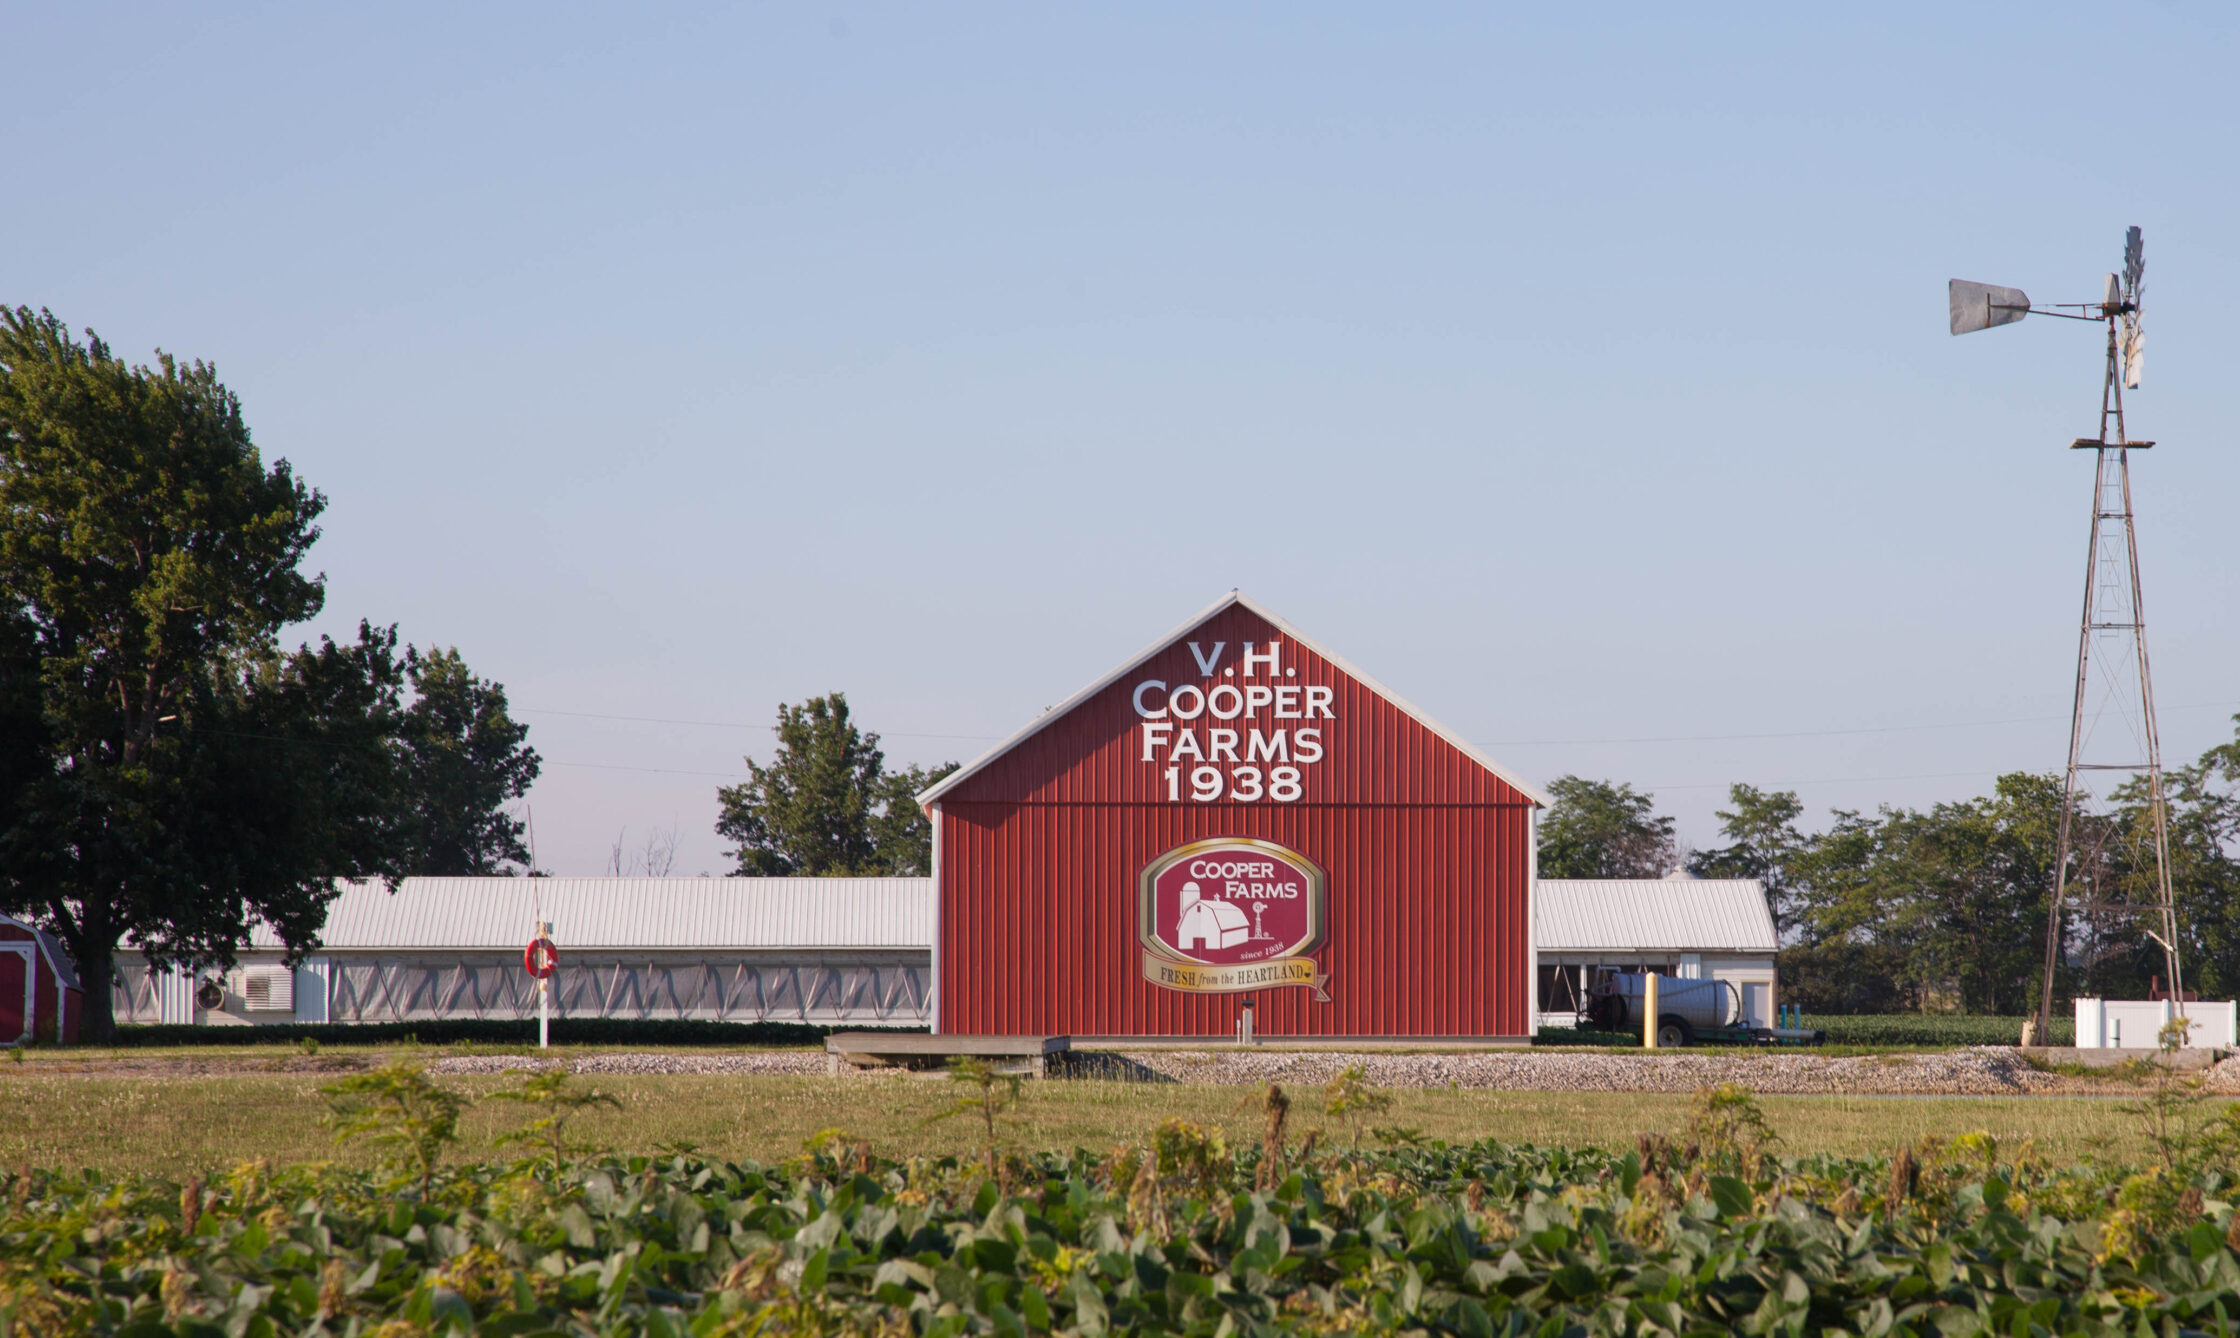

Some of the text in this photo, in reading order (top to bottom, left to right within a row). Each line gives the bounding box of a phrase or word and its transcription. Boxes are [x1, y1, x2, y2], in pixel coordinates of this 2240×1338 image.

[1132, 679, 1336, 720] COOPER
[1141, 722, 1323, 763] FARMS
[1164, 766, 1302, 802] 1938
[1190, 860, 1275, 879] COOPER
[1225, 881, 1298, 899] FARMS
[1240, 941, 1285, 960] since 1938
[1160, 965, 1304, 988] FRESH from the HEARTLAND
